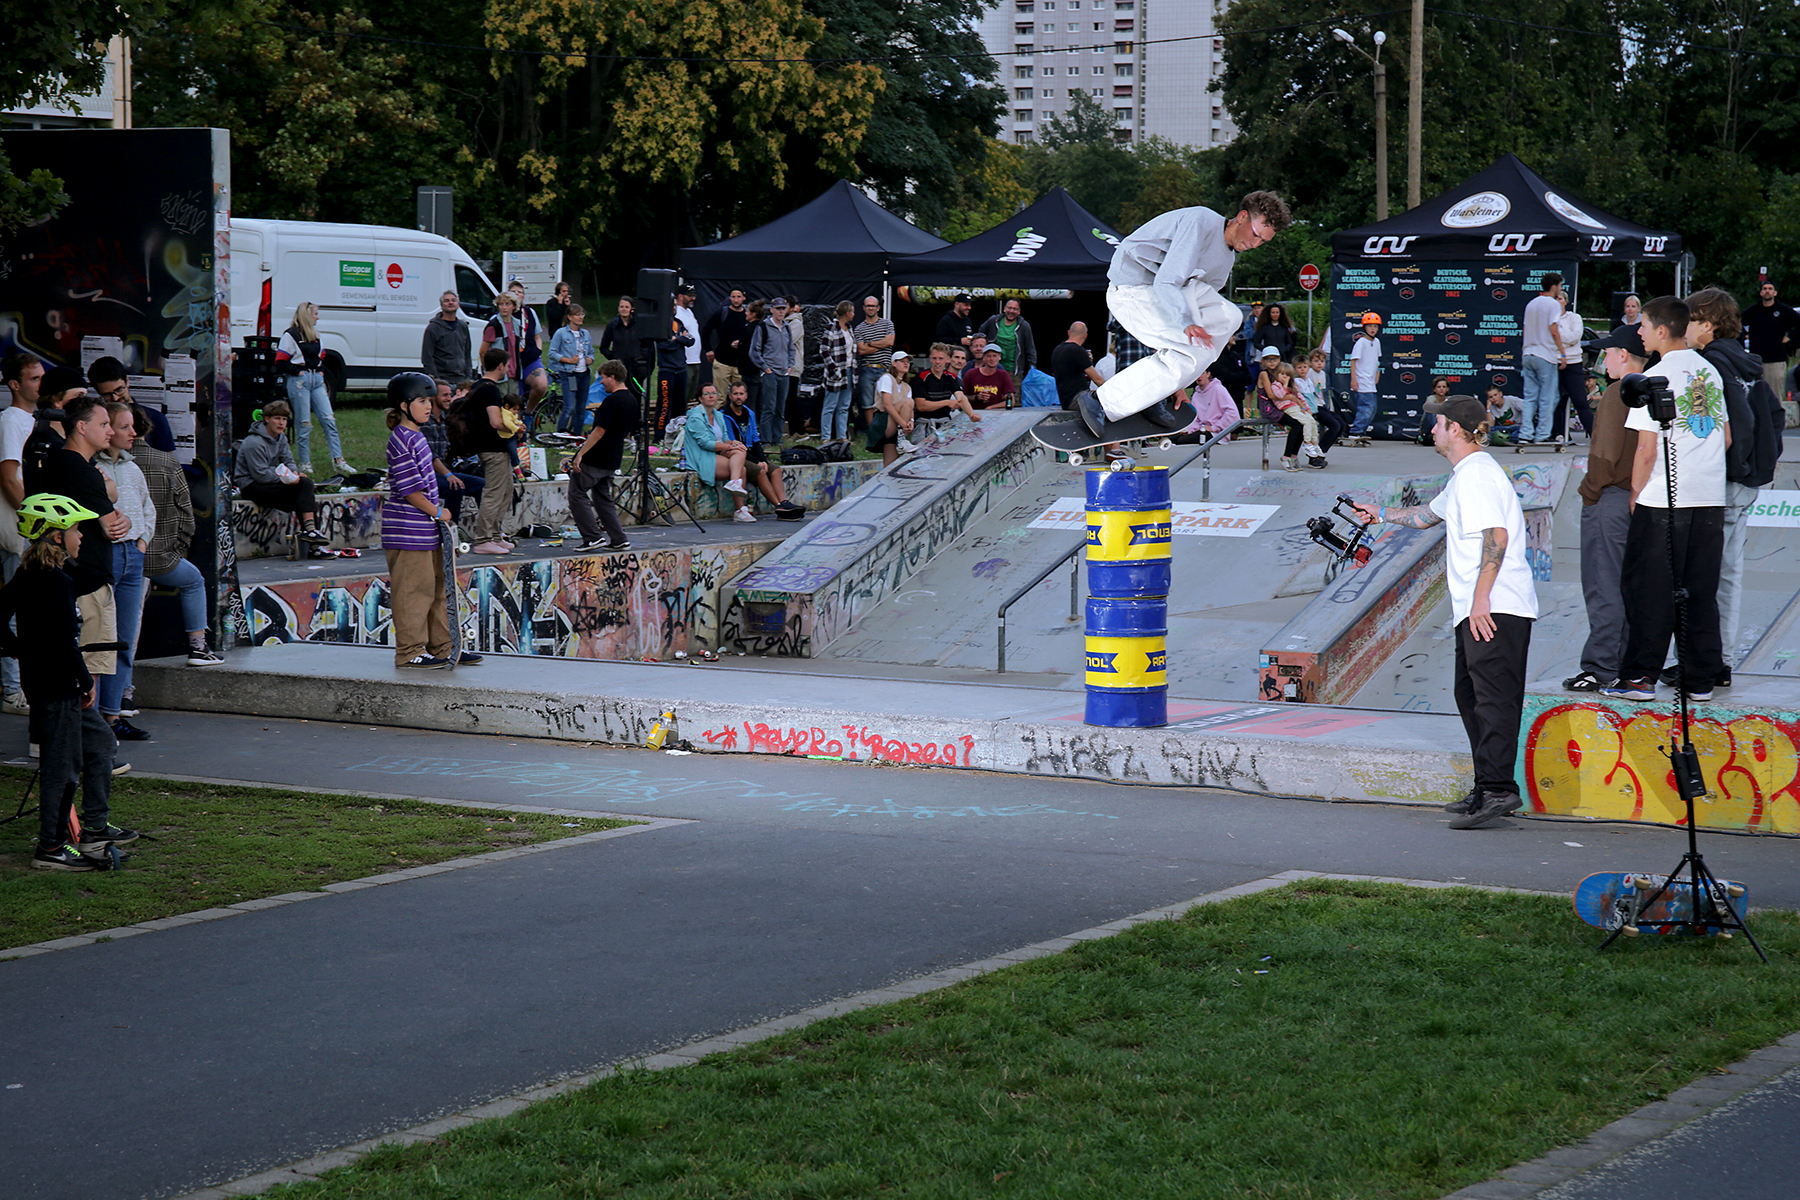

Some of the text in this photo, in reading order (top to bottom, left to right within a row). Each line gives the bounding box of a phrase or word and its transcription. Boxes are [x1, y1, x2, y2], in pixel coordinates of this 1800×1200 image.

[1450, 207, 1503, 218] Warsteiner
[342, 264, 372, 275] Europcar
[934, 287, 994, 299] purize.com
[1173, 516, 1257, 529] PARK
